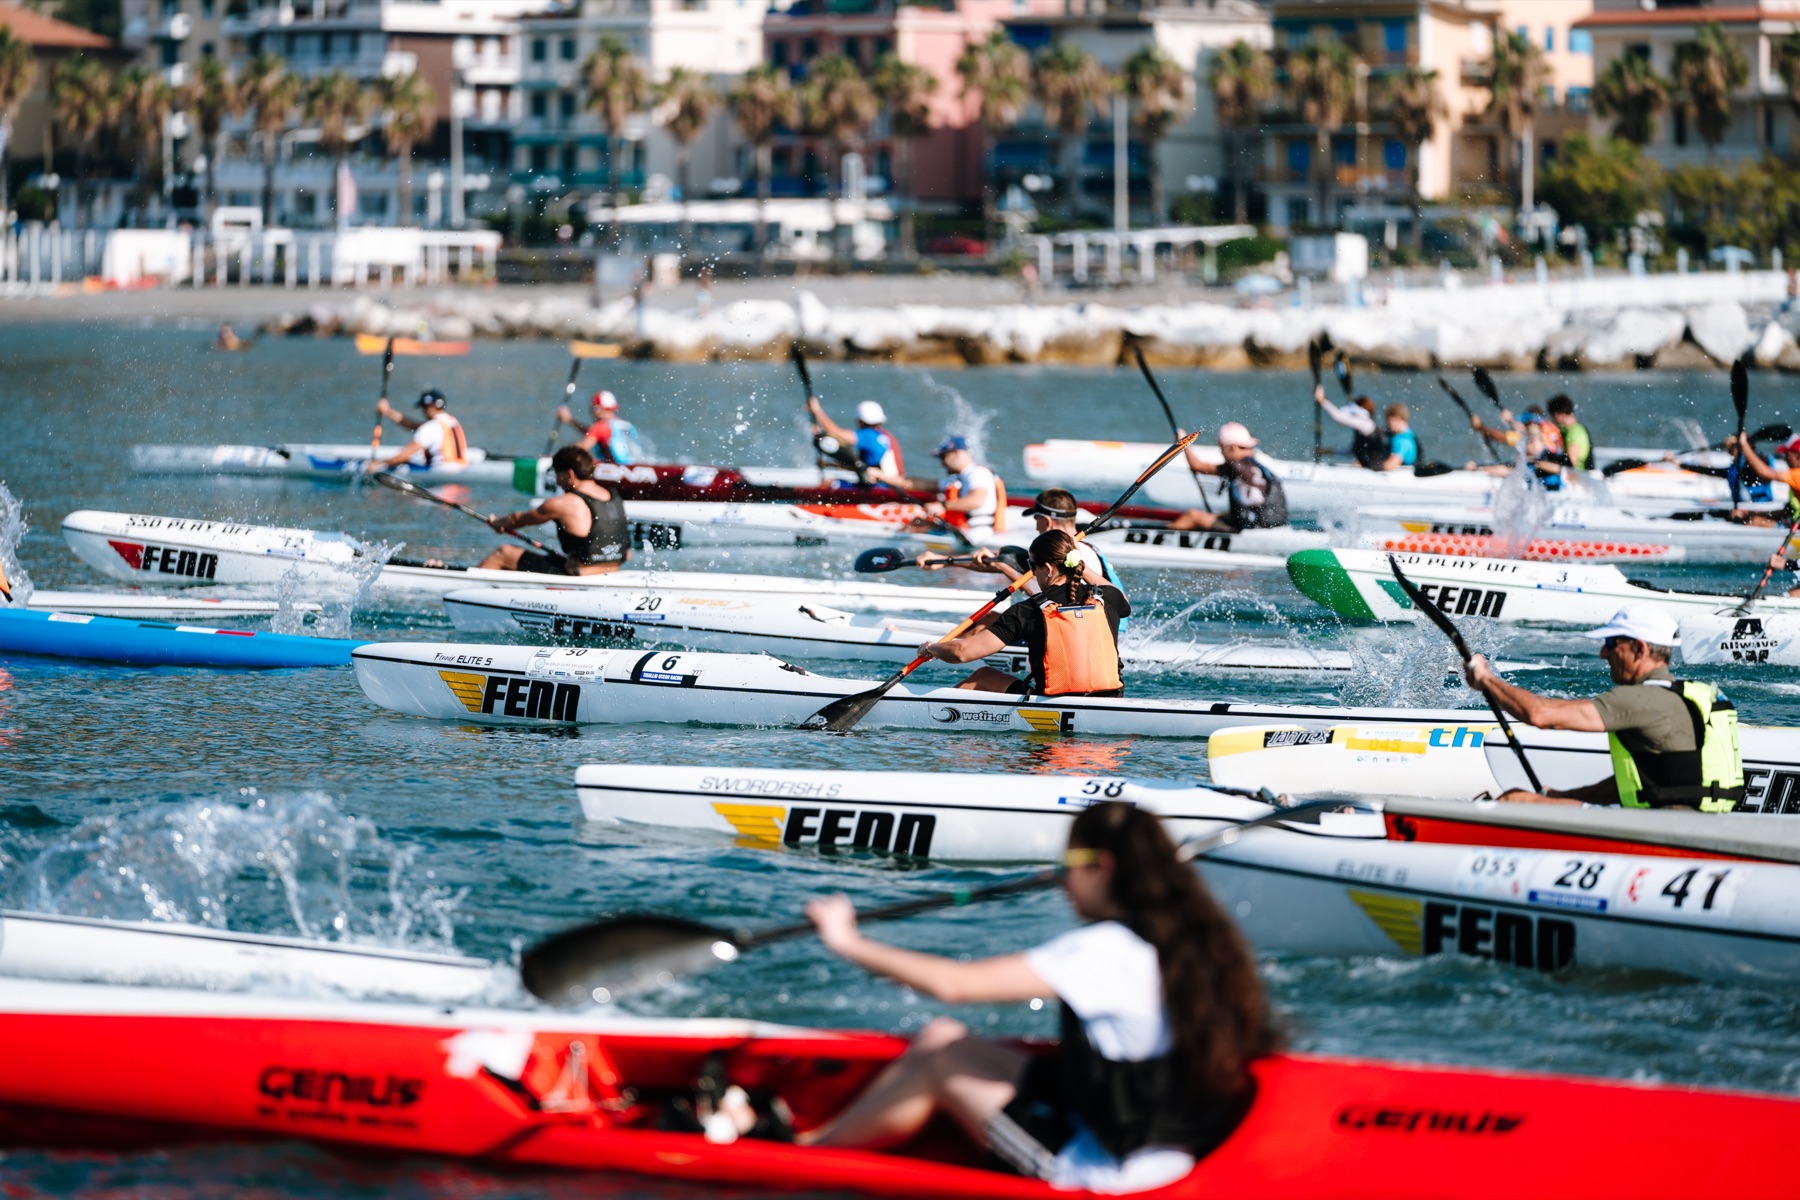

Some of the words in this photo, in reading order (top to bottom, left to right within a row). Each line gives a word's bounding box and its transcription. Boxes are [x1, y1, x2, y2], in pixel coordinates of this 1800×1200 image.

[142, 546, 218, 580] FENN
[1556, 571, 1568, 583] 3
[635, 596, 662, 611] 20
[457, 655, 483, 665] ELITE
[484, 657, 493, 666] S
[661, 655, 681, 671] 6
[482, 675, 581, 722] FENN
[962, 710, 1010, 723] wetiz.eu
[700, 776, 823, 797] SWORDFISH
[826, 783, 843, 798] S
[1082, 780, 1126, 798] 58
[783, 807, 937, 857] FENN
[1554, 859, 1606, 890] 28
[1422, 900, 1577, 972] FENN
[259, 1066, 425, 1108] GENIUS
